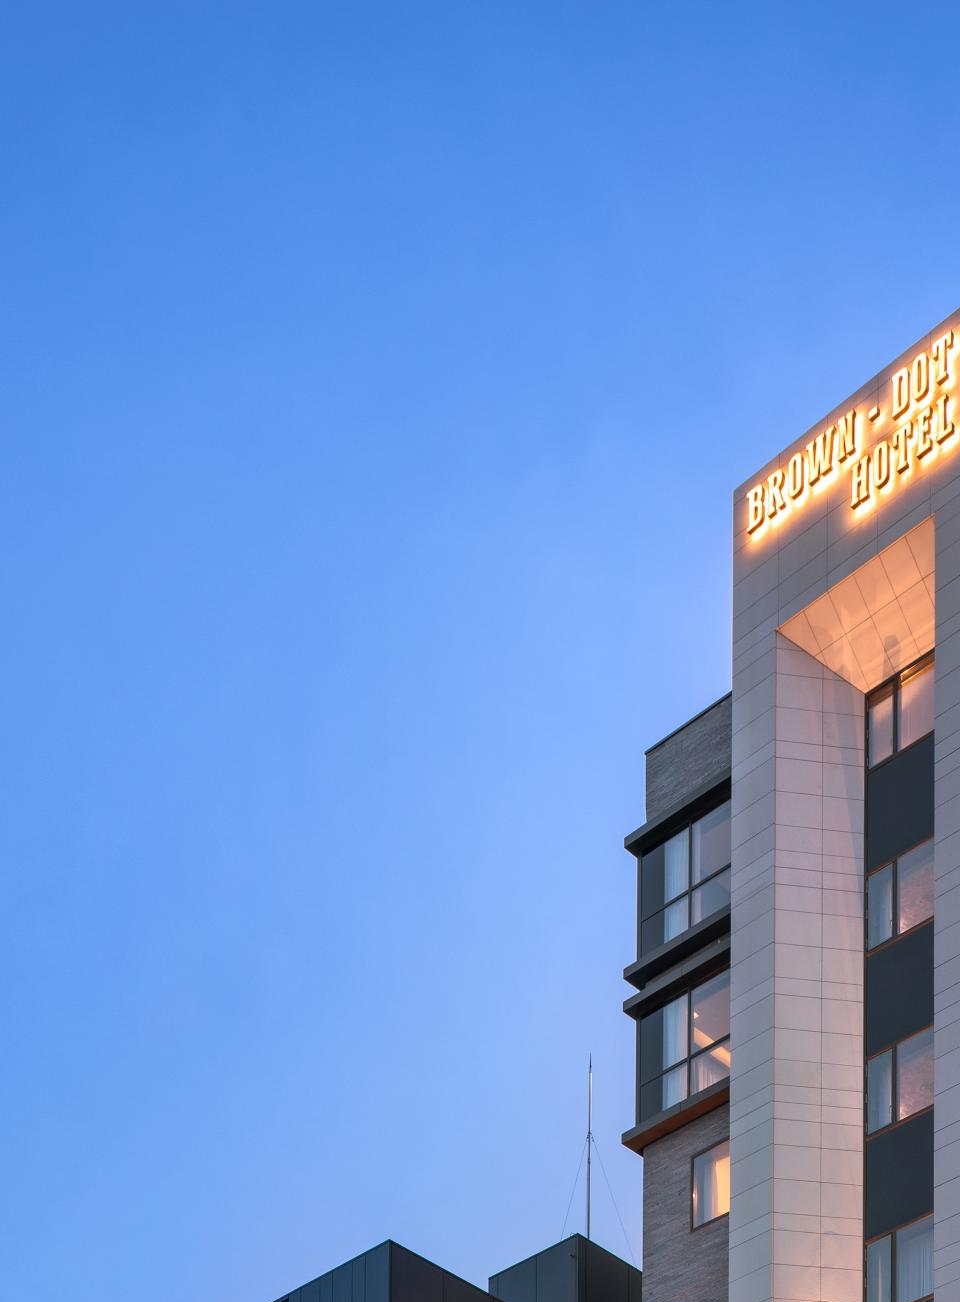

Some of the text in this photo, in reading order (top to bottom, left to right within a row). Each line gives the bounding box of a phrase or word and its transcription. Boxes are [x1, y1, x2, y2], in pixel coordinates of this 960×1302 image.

[746, 409, 857, 535] BROWN
[892, 330, 954, 421] DOT
[851, 394, 955, 510] HOTEL
